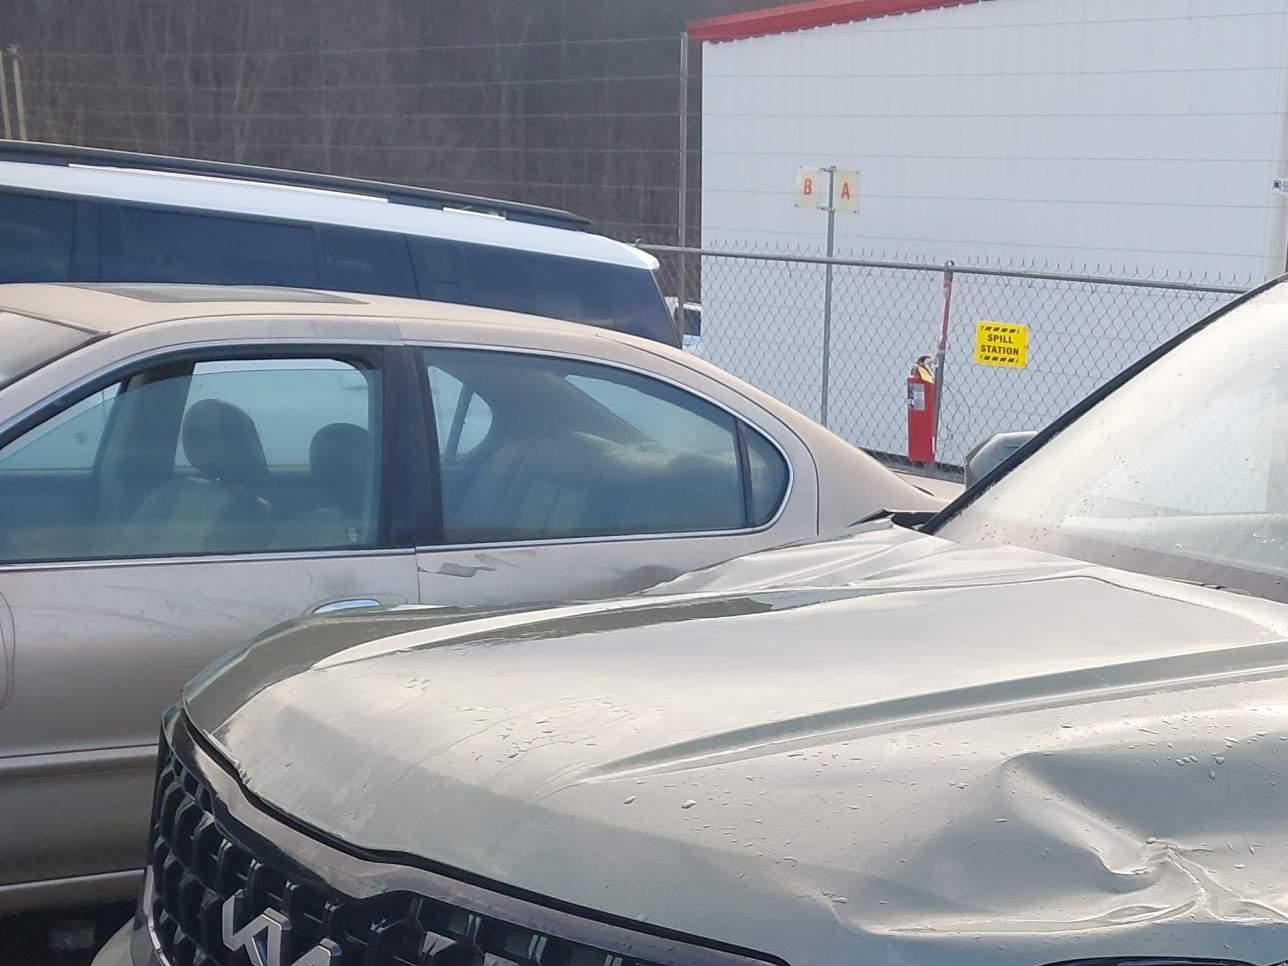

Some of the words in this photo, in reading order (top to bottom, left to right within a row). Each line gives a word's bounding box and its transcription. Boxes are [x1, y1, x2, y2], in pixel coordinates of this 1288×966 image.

[803, 178, 813, 196] B
[840, 181, 851, 200] A
[986, 333, 1014, 345] SPILL
[980, 344, 1020, 356] STATION
